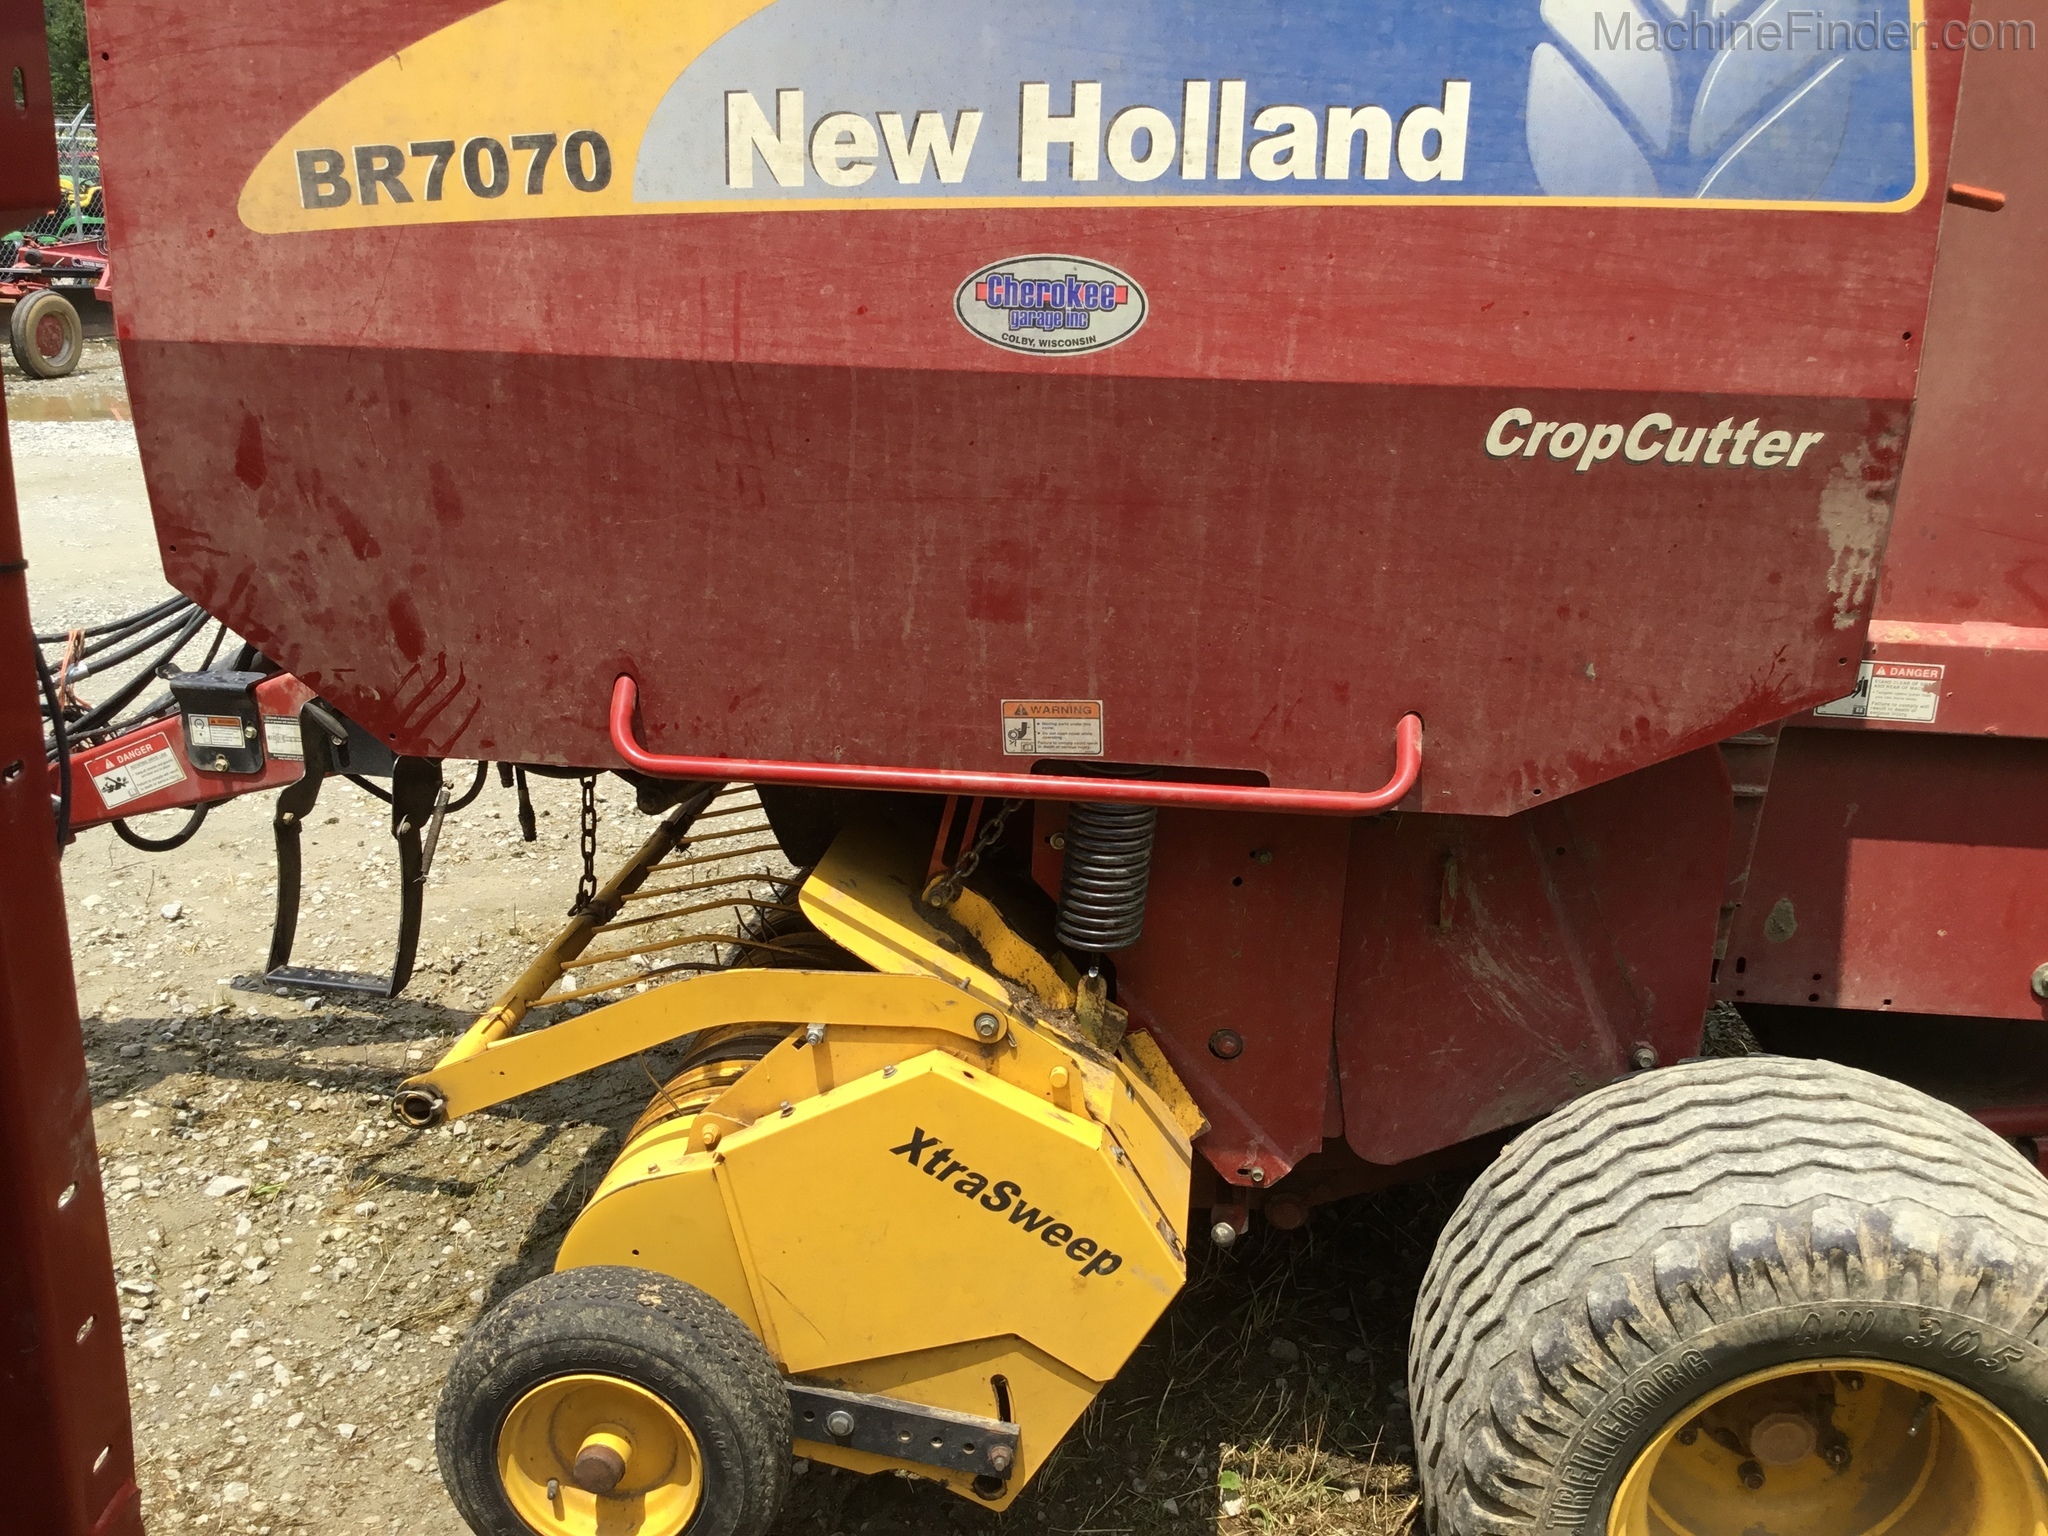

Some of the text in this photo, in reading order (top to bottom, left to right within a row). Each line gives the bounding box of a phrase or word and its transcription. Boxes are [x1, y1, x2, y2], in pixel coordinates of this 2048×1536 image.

[724, 78, 1473, 189] New Holland
[294, 129, 613, 210] BR7070
[986, 273, 1116, 310] Cherokee
[1001, 332, 1097, 348] COLBY, WISCONSIN
[1010, 308, 1090, 331] garage inc
[1484, 407, 1825, 474] CropCutter
[1889, 667, 1939, 679] DANGER
[1030, 705, 1092, 715] WARNING
[116, 743, 154, 764] DANGER
[889, 1126, 1123, 1278] XtraSweep
[1902, 1316, 2025, 1374] 305
[487, 1352, 544, 1401] SURE
[556, 1347, 640, 1370] TRAIL
[1546, 1349, 1713, 1530] TRELLEBORG
